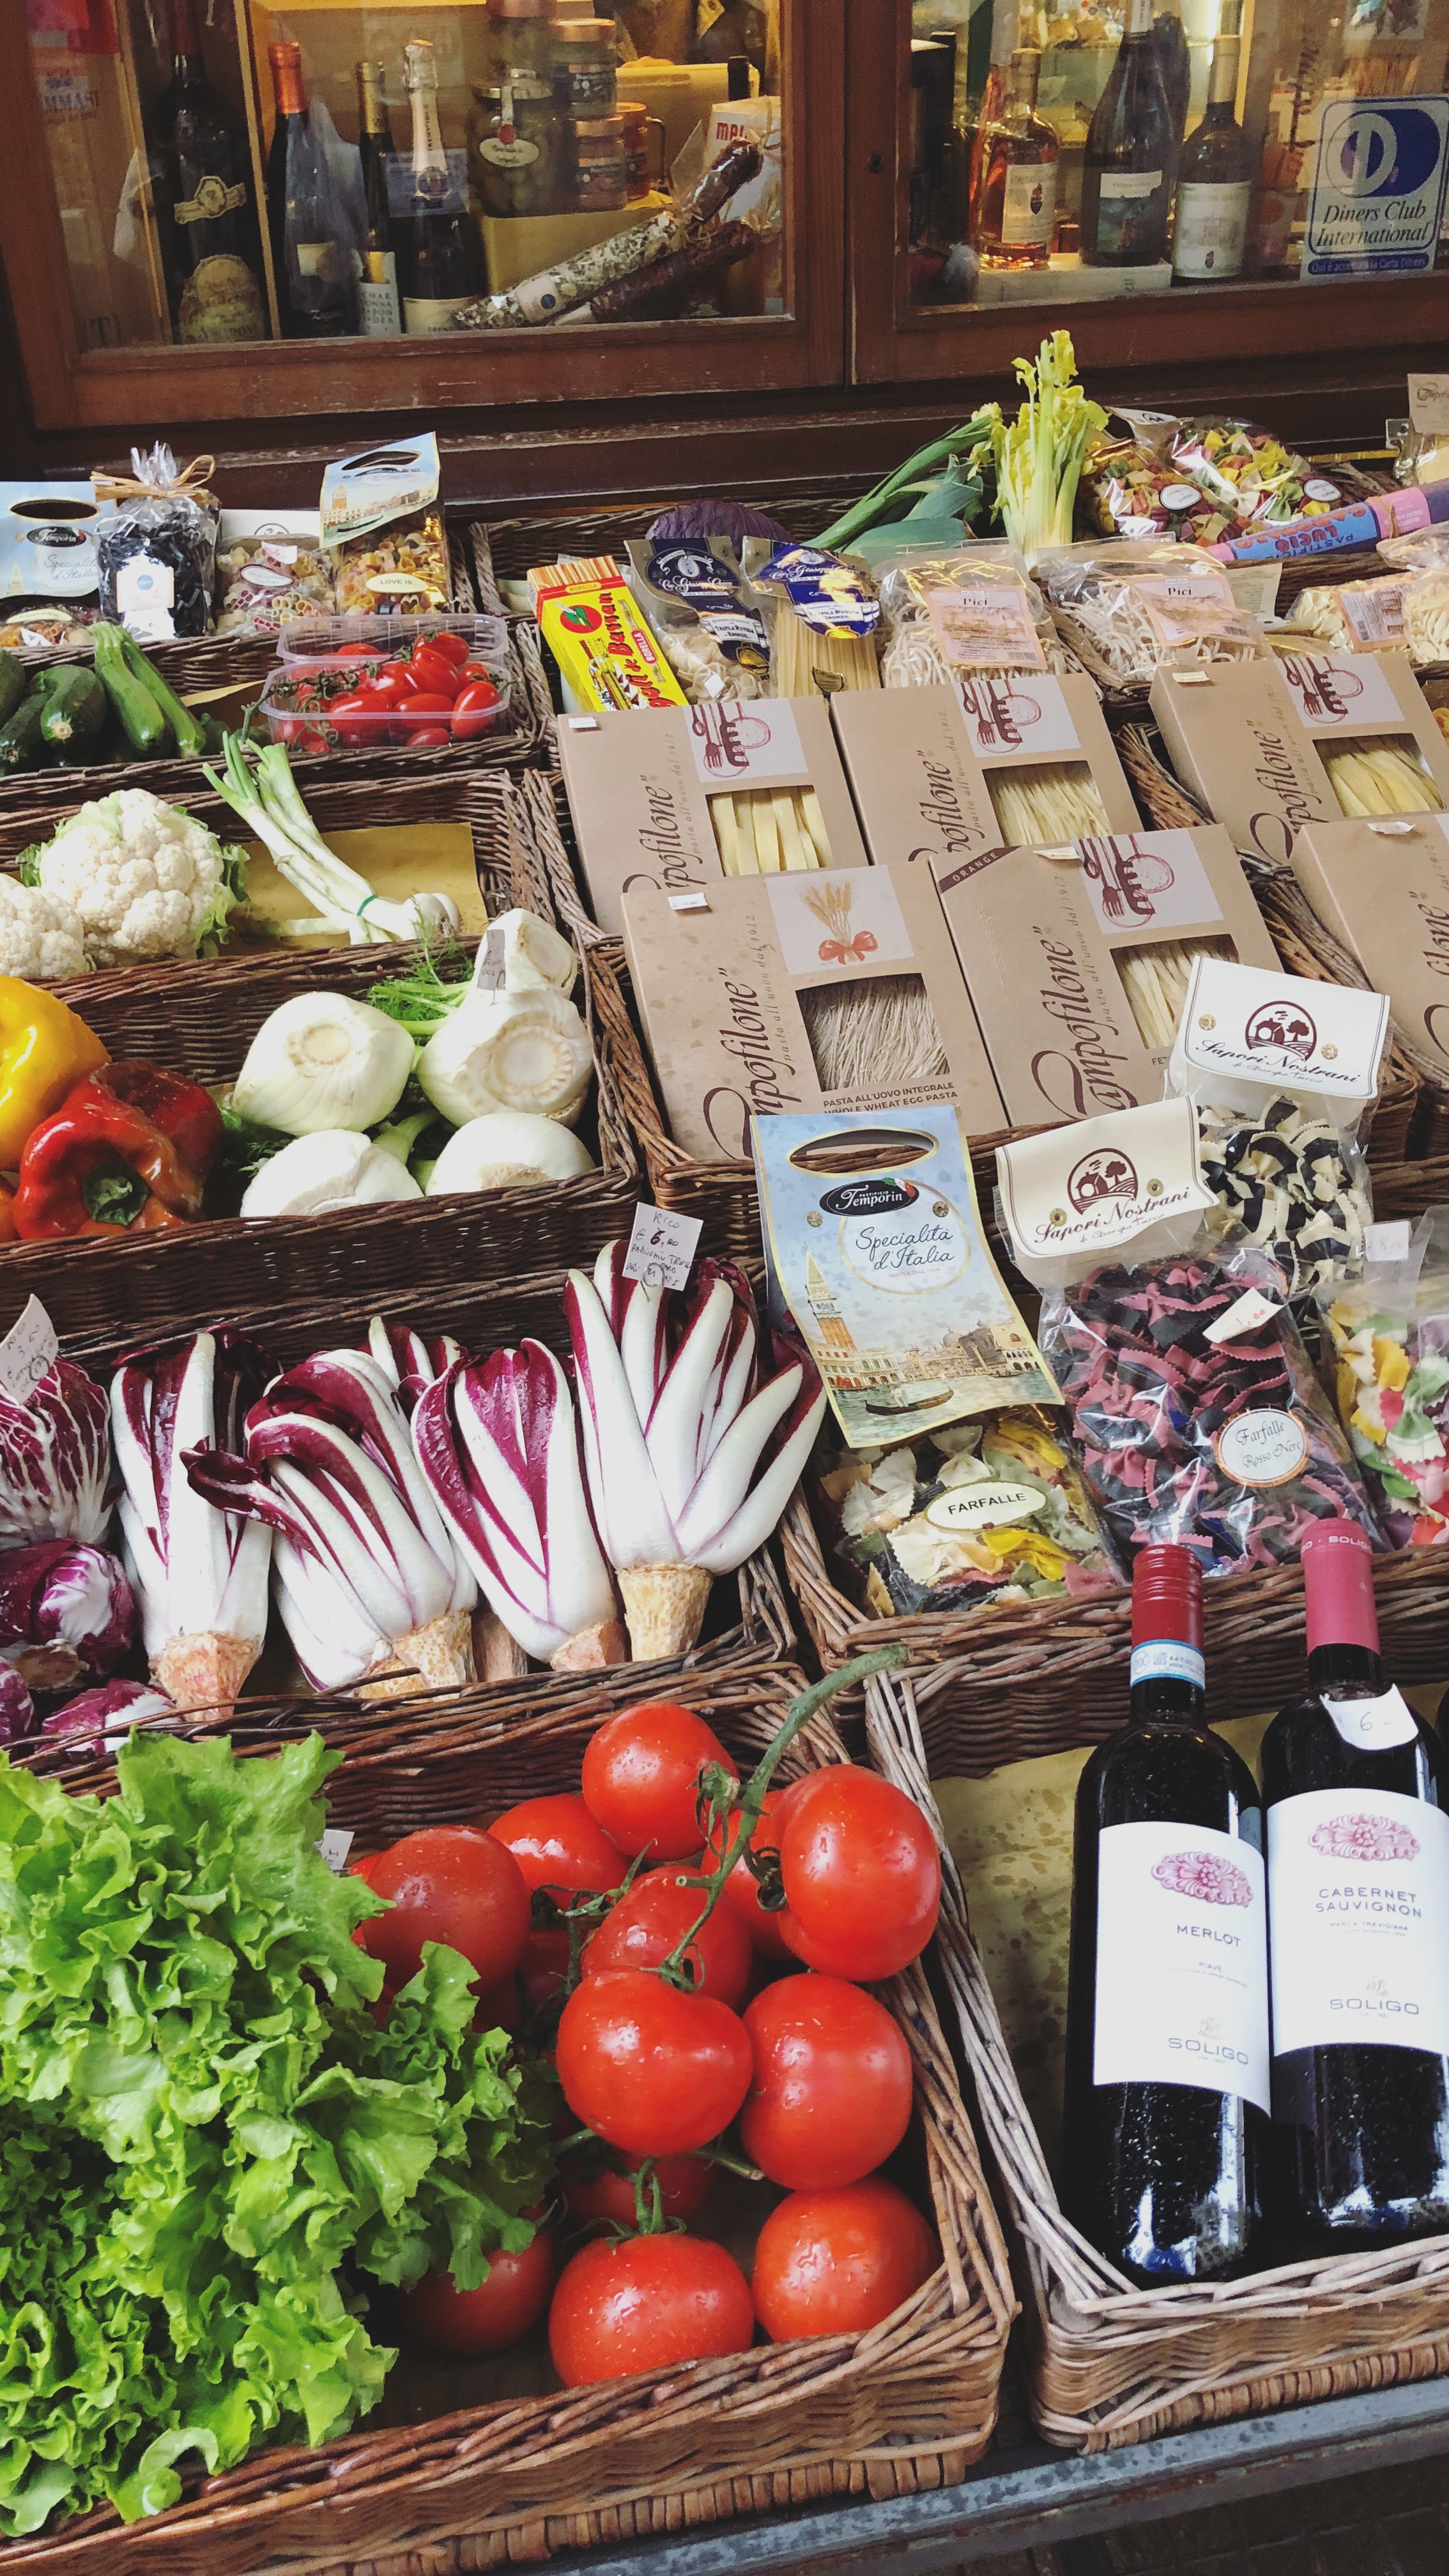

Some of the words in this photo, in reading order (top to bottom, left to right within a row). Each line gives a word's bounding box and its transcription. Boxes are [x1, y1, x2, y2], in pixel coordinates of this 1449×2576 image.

[1324, 203, 1379, 224] Diners
[1385, 199, 1426, 220] Club
[1316, 221, 1434, 247] International
[35, 528, 77, 542] Temporin
[1266, 533, 1354, 560] PASTIFIC
[1275, 524, 1338, 553] LUCIO
[569, 583, 598, 592] BORELLA
[1167, 586, 1192, 595] Pici
[963, 597, 988, 606] Pici
[634, 632, 656, 662] BORELLA
[951, 852, 999, 882] ORANGE
[778, 1027, 795, 1062] pasta
[1195, 1039, 1268, 1063] Sapori
[1266, 1055, 1361, 1083] Nostrani
[823, 1097, 854, 1107] PASTA
[855, 1089, 901, 1102] ALL'UOVO
[902, 1082, 954, 1095] INTEGRALE
[864, 1100, 900, 1112] WHEAT
[903, 1095, 924, 1105] EGG
[926, 1091, 958, 1101] PASTA
[835, 1184, 903, 1209] Temporin
[1034, 1213, 1101, 1243] Sapori
[1103, 1186, 1190, 1226] Nostrani
[855, 1223, 954, 1262] Specialità
[873, 1245, 955, 1270] d'Italia
[1236, 1420, 1285, 1446] Farfalle
[1242, 1453, 1271, 1468] Rosso
[947, 1492, 1027, 1515] FARFALLE
[1319, 1887, 1417, 1903] CABERNET
[1315, 1901, 1422, 1918] SAUVIGNON
[1177, 1924, 1241, 1947] MERLOT
[1199, 1961, 1223, 1973] PIAVE
[1330, 1998, 1420, 2015] SOLIGO
[1168, 2037, 1249, 2066] SOLIGO
